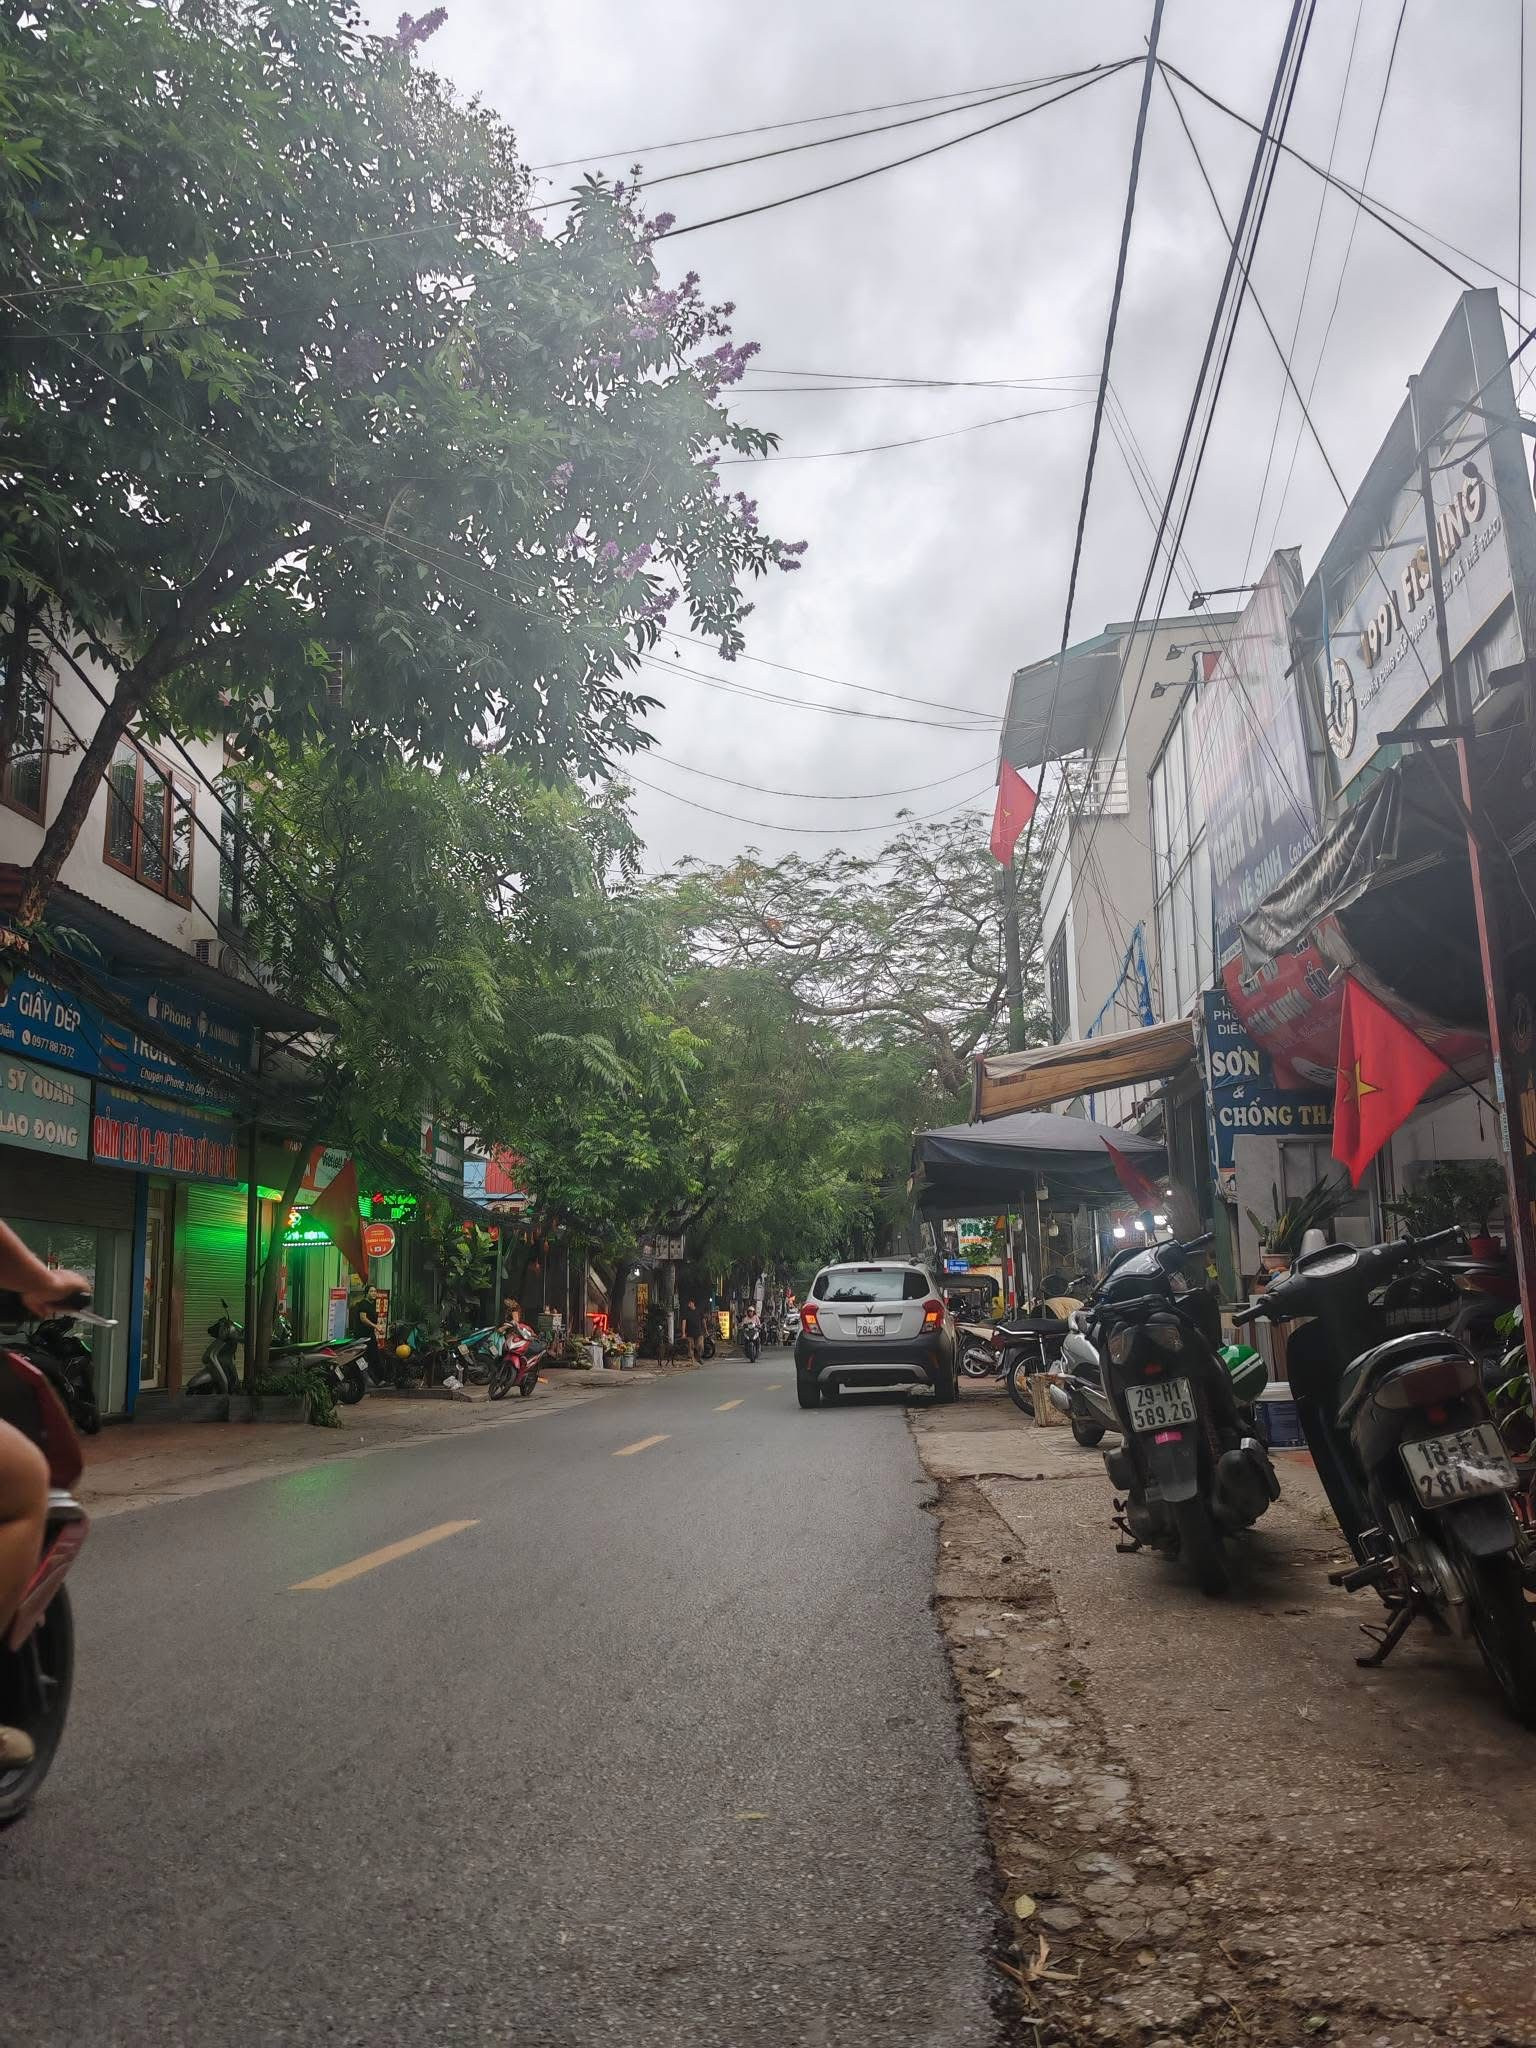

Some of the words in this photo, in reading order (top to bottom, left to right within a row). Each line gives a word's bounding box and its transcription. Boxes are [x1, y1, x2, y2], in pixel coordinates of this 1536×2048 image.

[161, 1001, 192, 1030] iPhone
[1211, 1046, 1260, 1077] SƠN
[1232, 1085, 1245, 1099] &
[1219, 1096, 1293, 1128] CHỐNG
[1135, 1381, 1181, 1408] 29-H1
